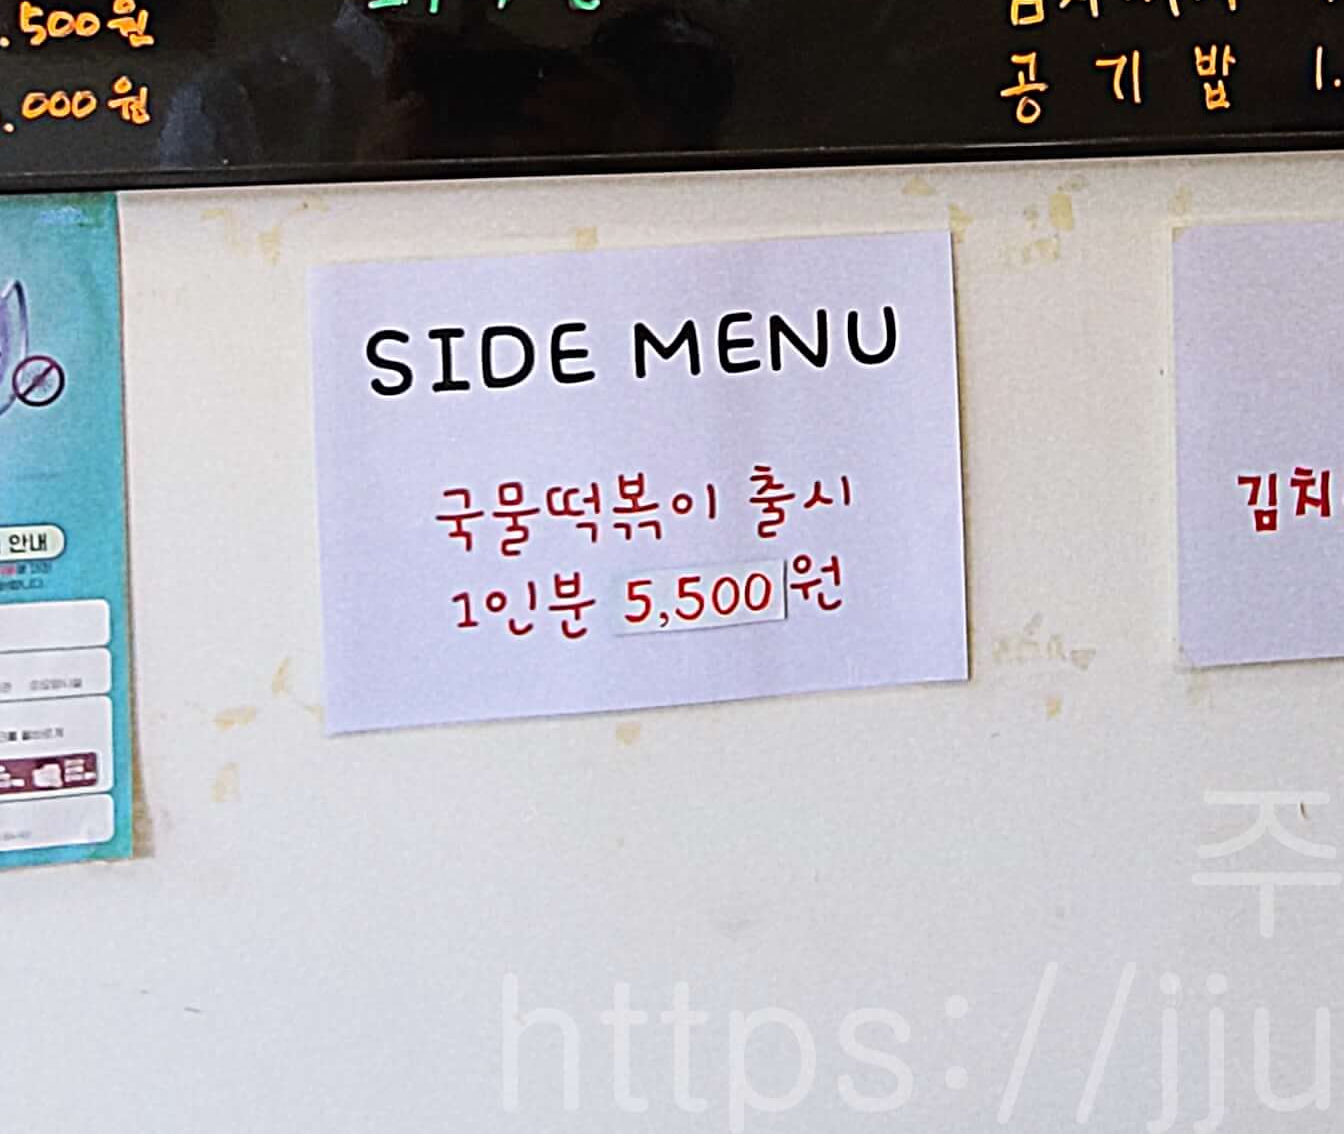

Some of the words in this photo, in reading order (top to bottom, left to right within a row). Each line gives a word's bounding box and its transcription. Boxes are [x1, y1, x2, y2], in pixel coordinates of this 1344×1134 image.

[364, 320, 597, 398] SIDE
[632, 304, 898, 380] MENU
[747, 464, 852, 540] 출시
[9, 533, 47, 553] 안내
[450, 570, 598, 641] 1인분
